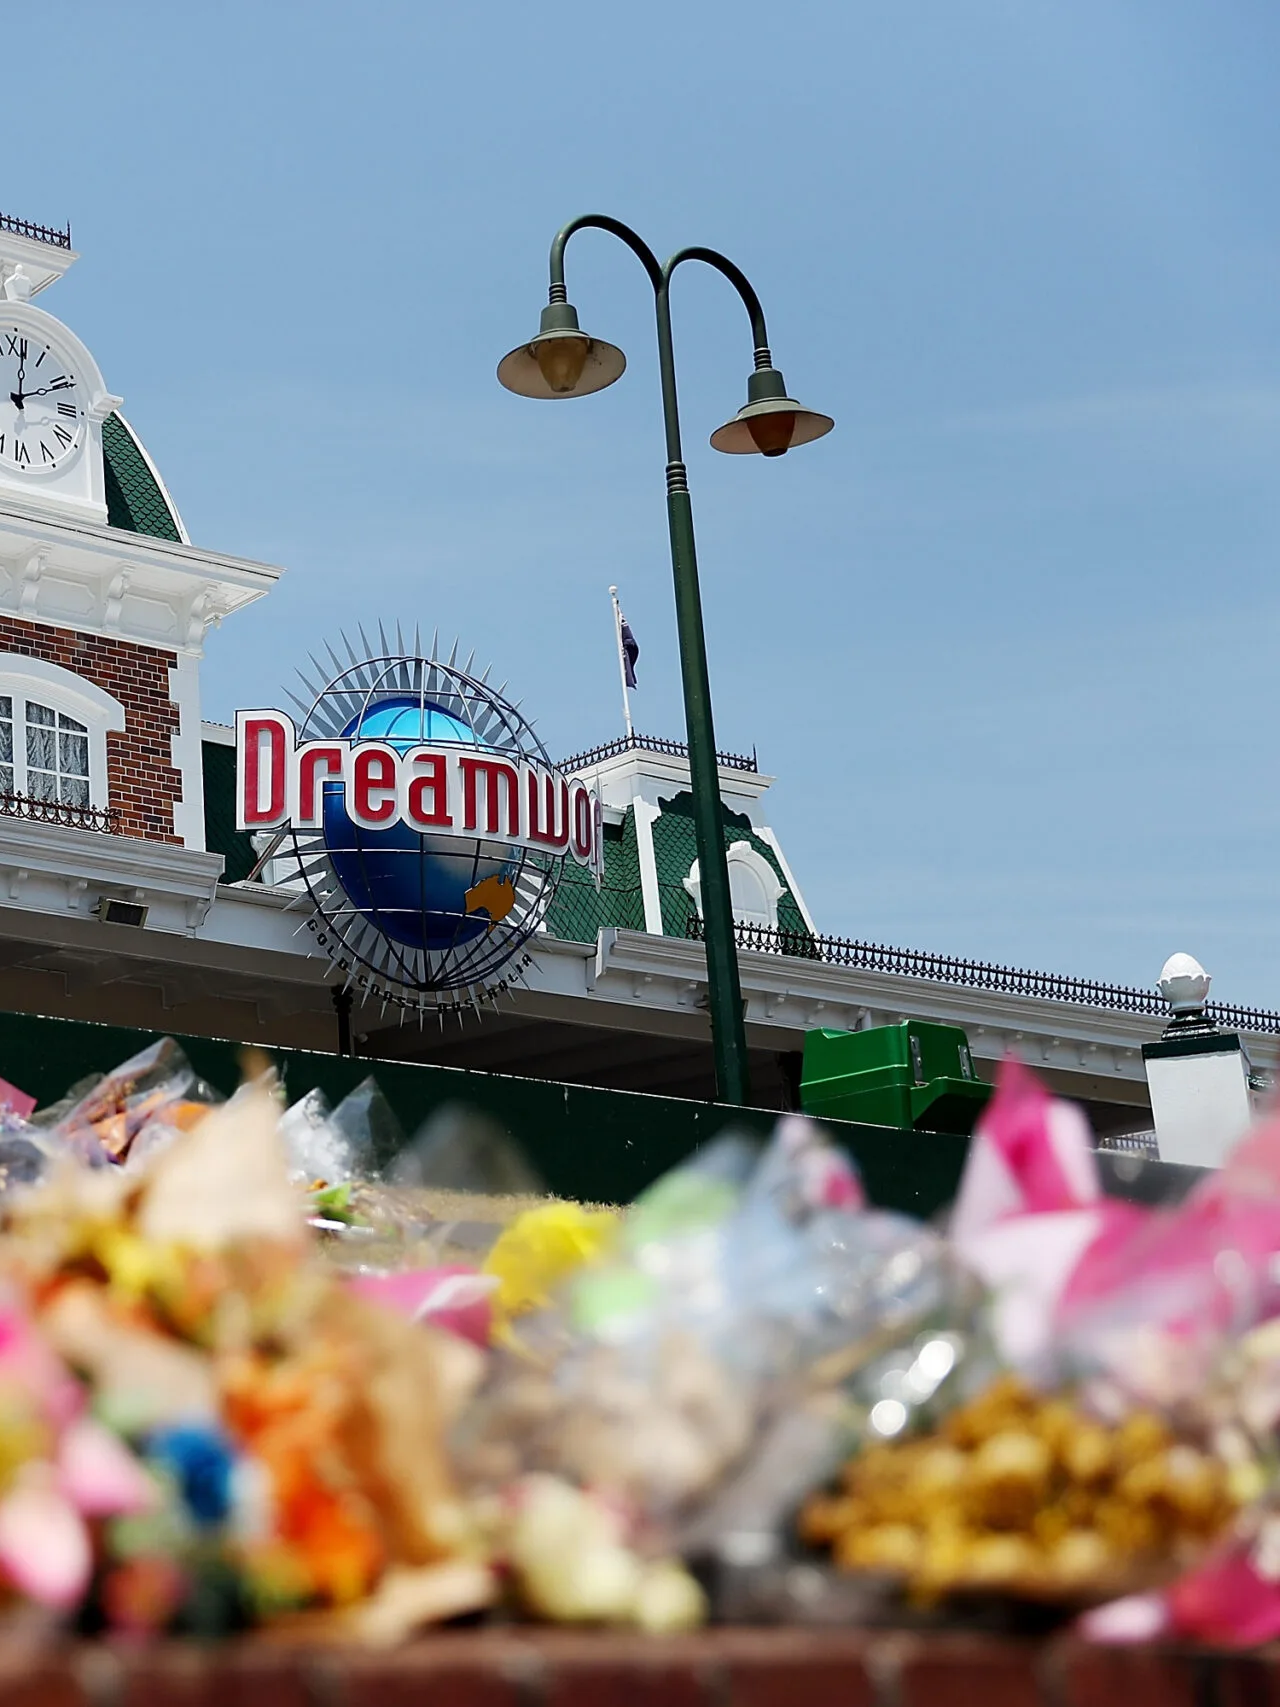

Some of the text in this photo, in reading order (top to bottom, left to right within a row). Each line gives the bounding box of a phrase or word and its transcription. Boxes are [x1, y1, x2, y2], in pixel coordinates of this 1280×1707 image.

[57, 402, 77, 419] III
[52, 424, 73, 450] IV
[14, 439, 31, 463] VI
[39, 440, 55, 462] V
[306, 918, 349, 971] GOLD
[437, 953, 533, 1014] AUSTRALIA
